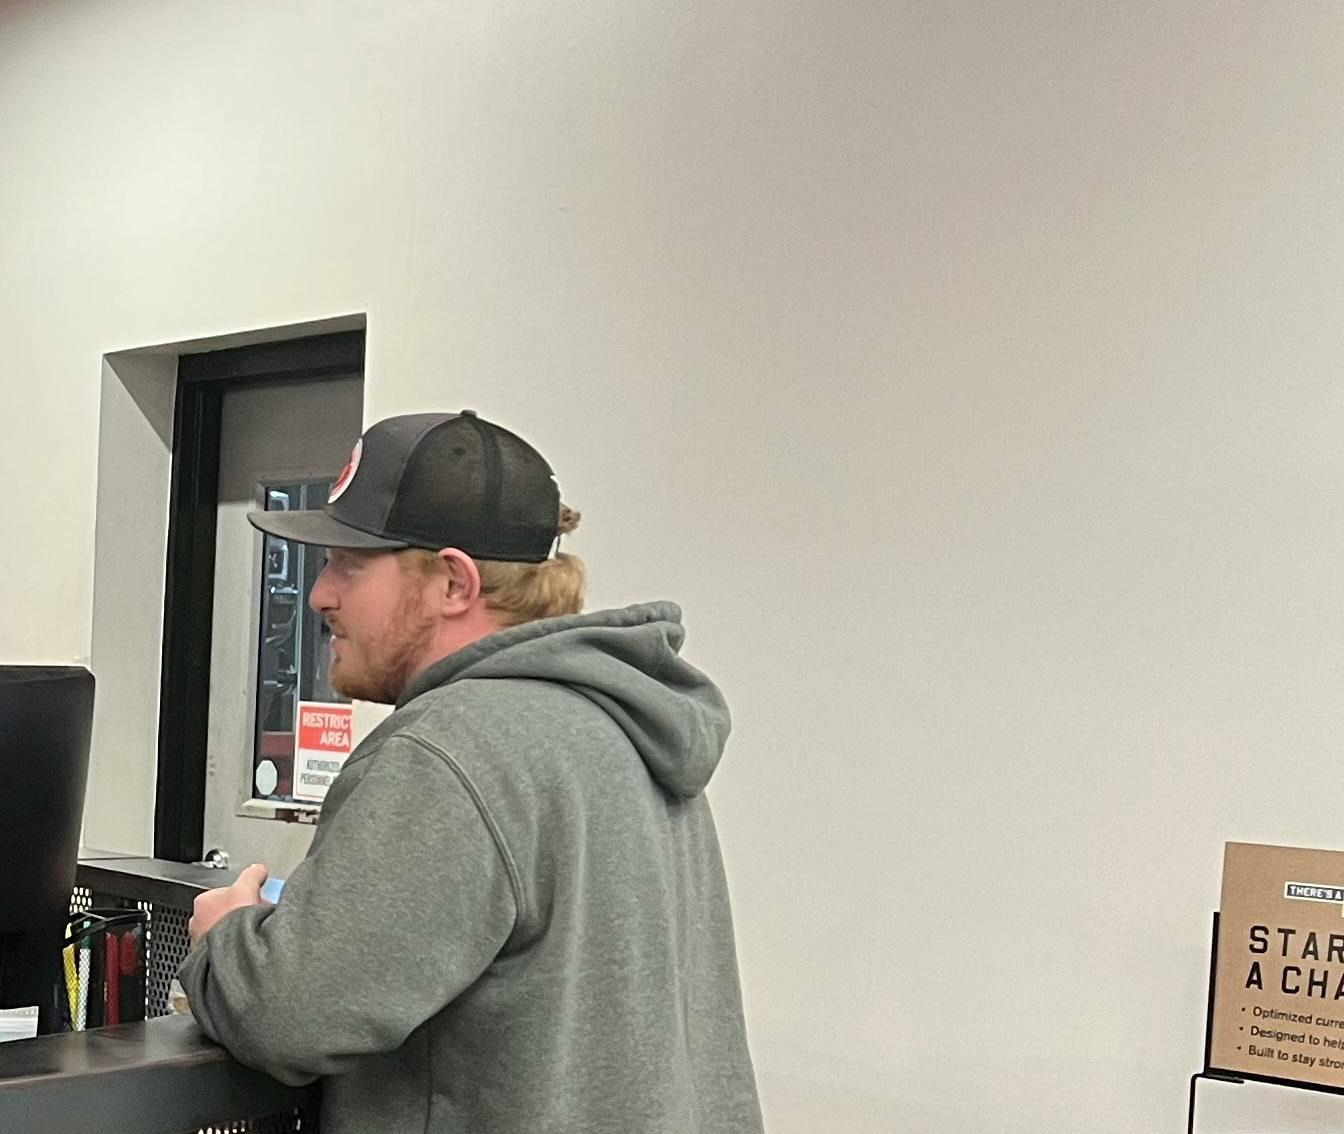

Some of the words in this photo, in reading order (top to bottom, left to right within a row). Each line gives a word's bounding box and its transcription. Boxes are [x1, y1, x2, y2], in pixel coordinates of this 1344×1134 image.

[320, 731, 349, 747] AREA
[1248, 925, 1344, 964] STAR
[1245, 961, 1263, 990] A
[1253, 1006, 1313, 1024] Optimized
[1251, 1025, 1306, 1043] Designed
[1308, 1034, 1321, 1046] to
[1278, 1049, 1289, 1061] to
[1292, 1053, 1316, 1067] stay
